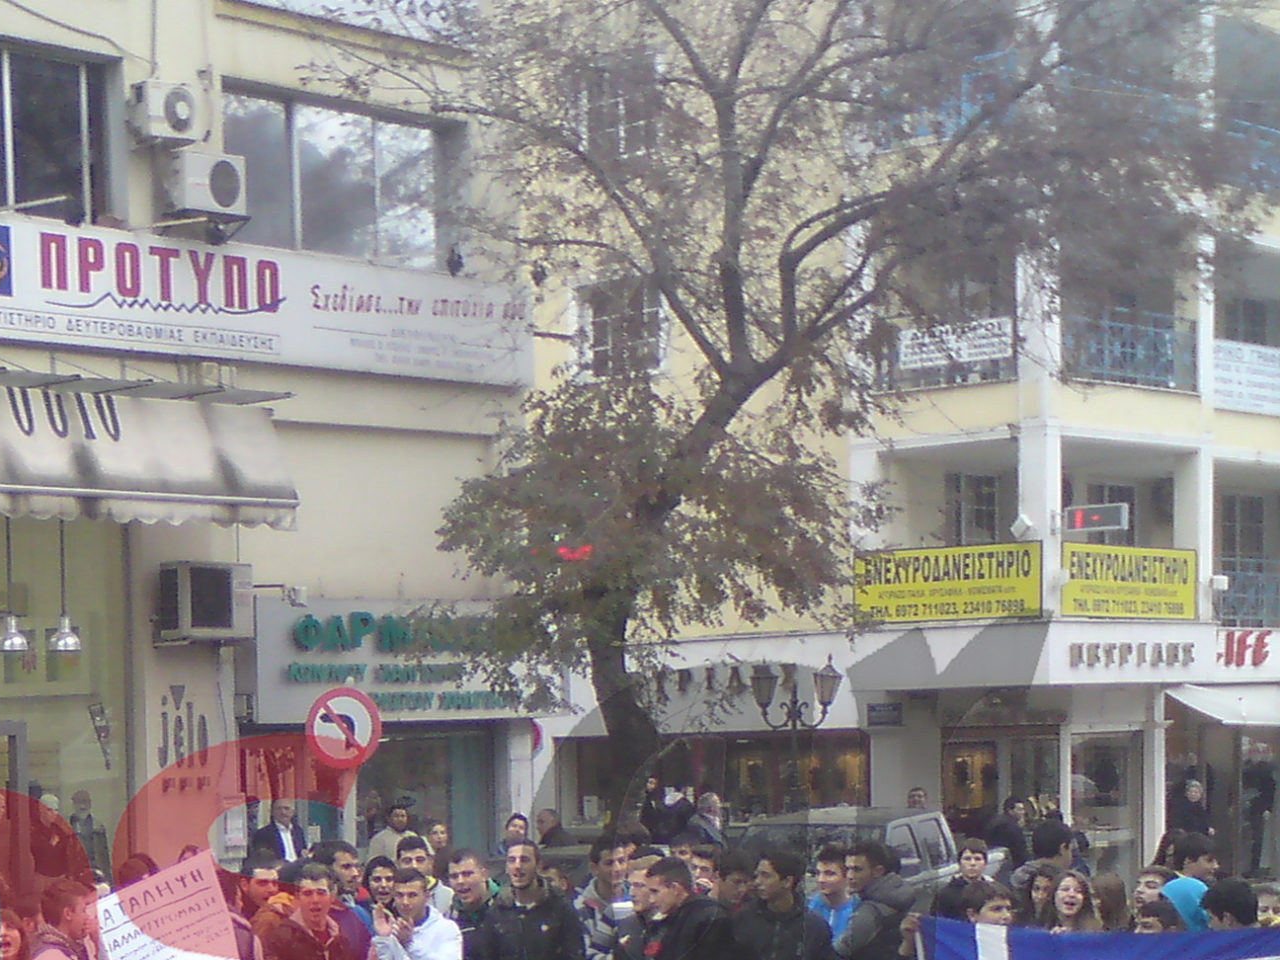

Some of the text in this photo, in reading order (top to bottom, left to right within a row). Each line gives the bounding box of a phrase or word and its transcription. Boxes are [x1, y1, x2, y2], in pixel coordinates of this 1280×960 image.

[39, 231, 281, 313] ΠΡΟΤΥΠΟ
[65, 318, 184, 343] ΔΕΥΤΕΡΟΒΑΘΜΙΑΣ
[863, 549, 1033, 587] ΕΝΕΧΥΡΟΔΑΝΕΙΣΤΗΡΙΟ
